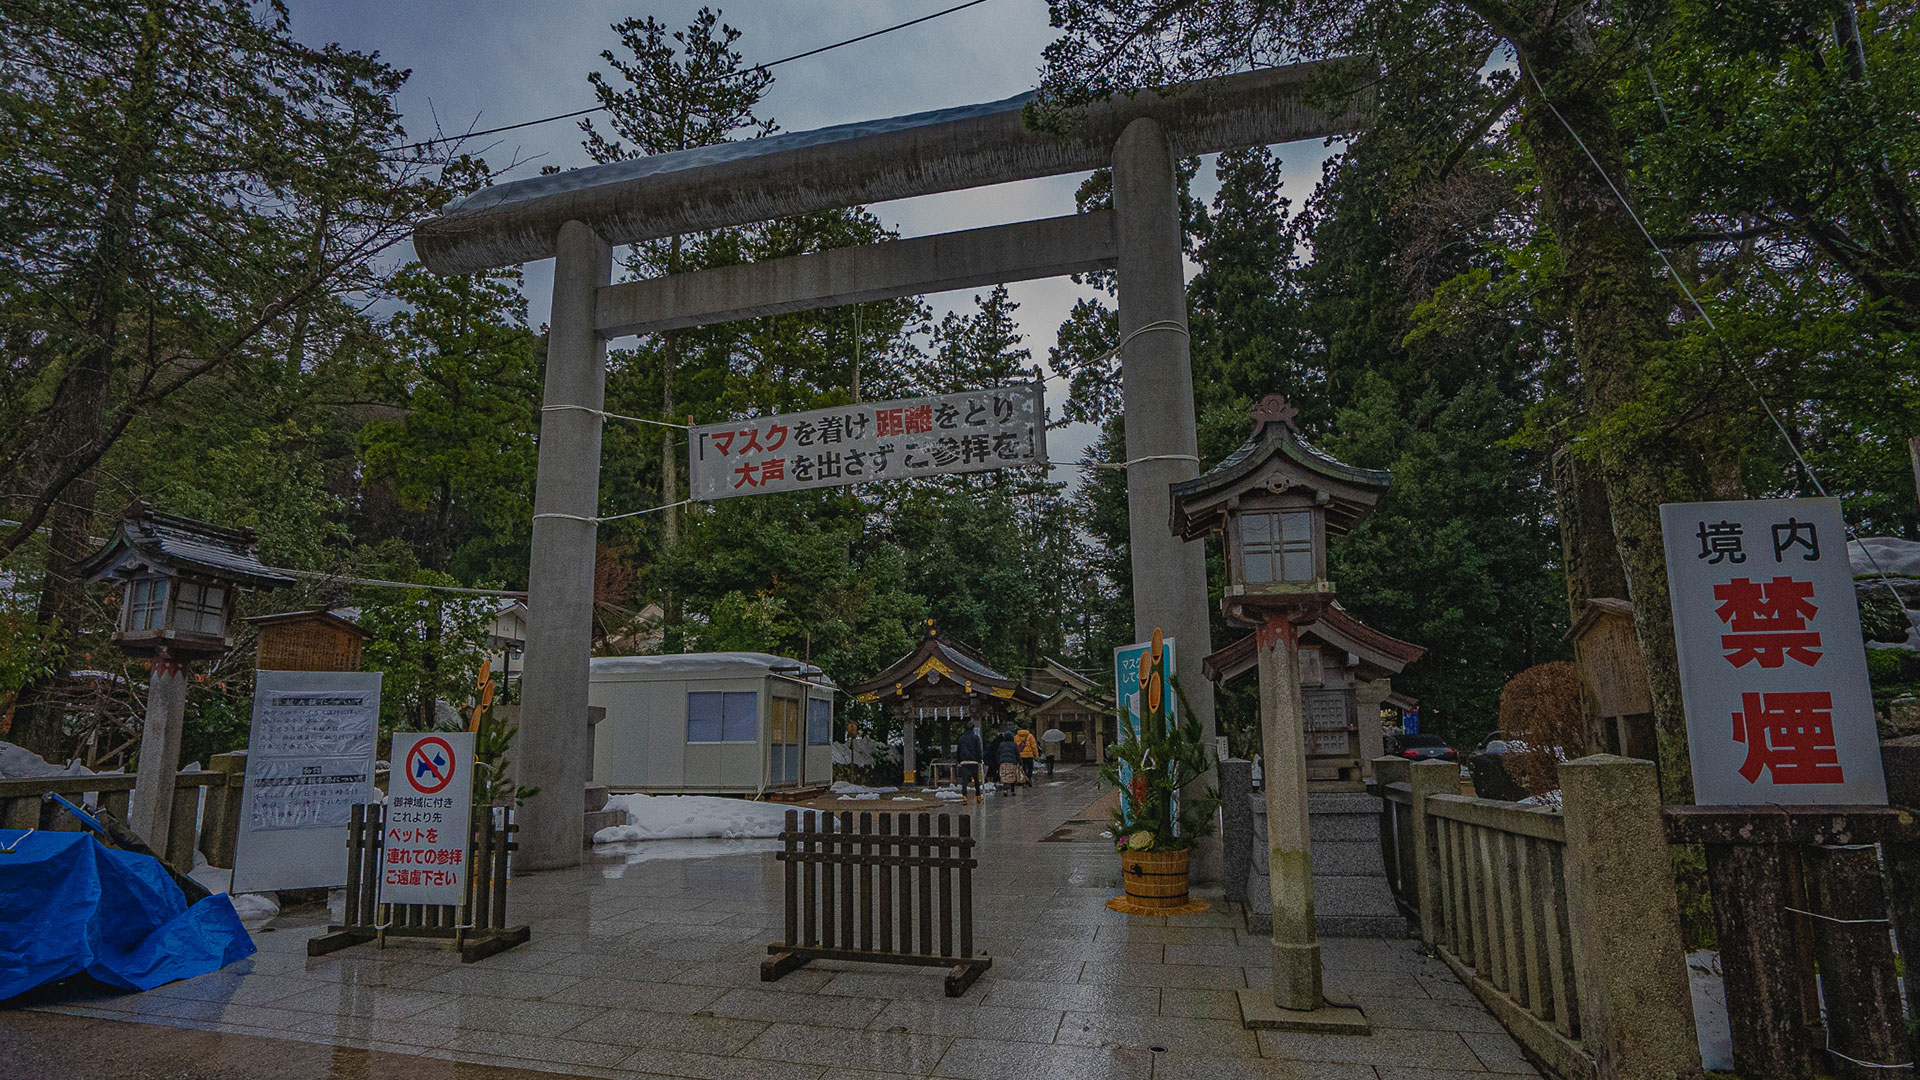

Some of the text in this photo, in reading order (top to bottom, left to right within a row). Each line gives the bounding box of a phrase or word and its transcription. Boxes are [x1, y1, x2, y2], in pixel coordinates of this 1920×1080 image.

[1696, 517, 1820, 564] 境内
[1713, 576, 1845, 785] 禁煙
[393, 797, 453, 809] 御神域に付き
[392, 811, 443, 823] これより先
[388, 828, 438, 844] ペットを
[386, 848, 462, 865] 連れての参拝
[386, 869, 457, 887] ご遠慮下さい
